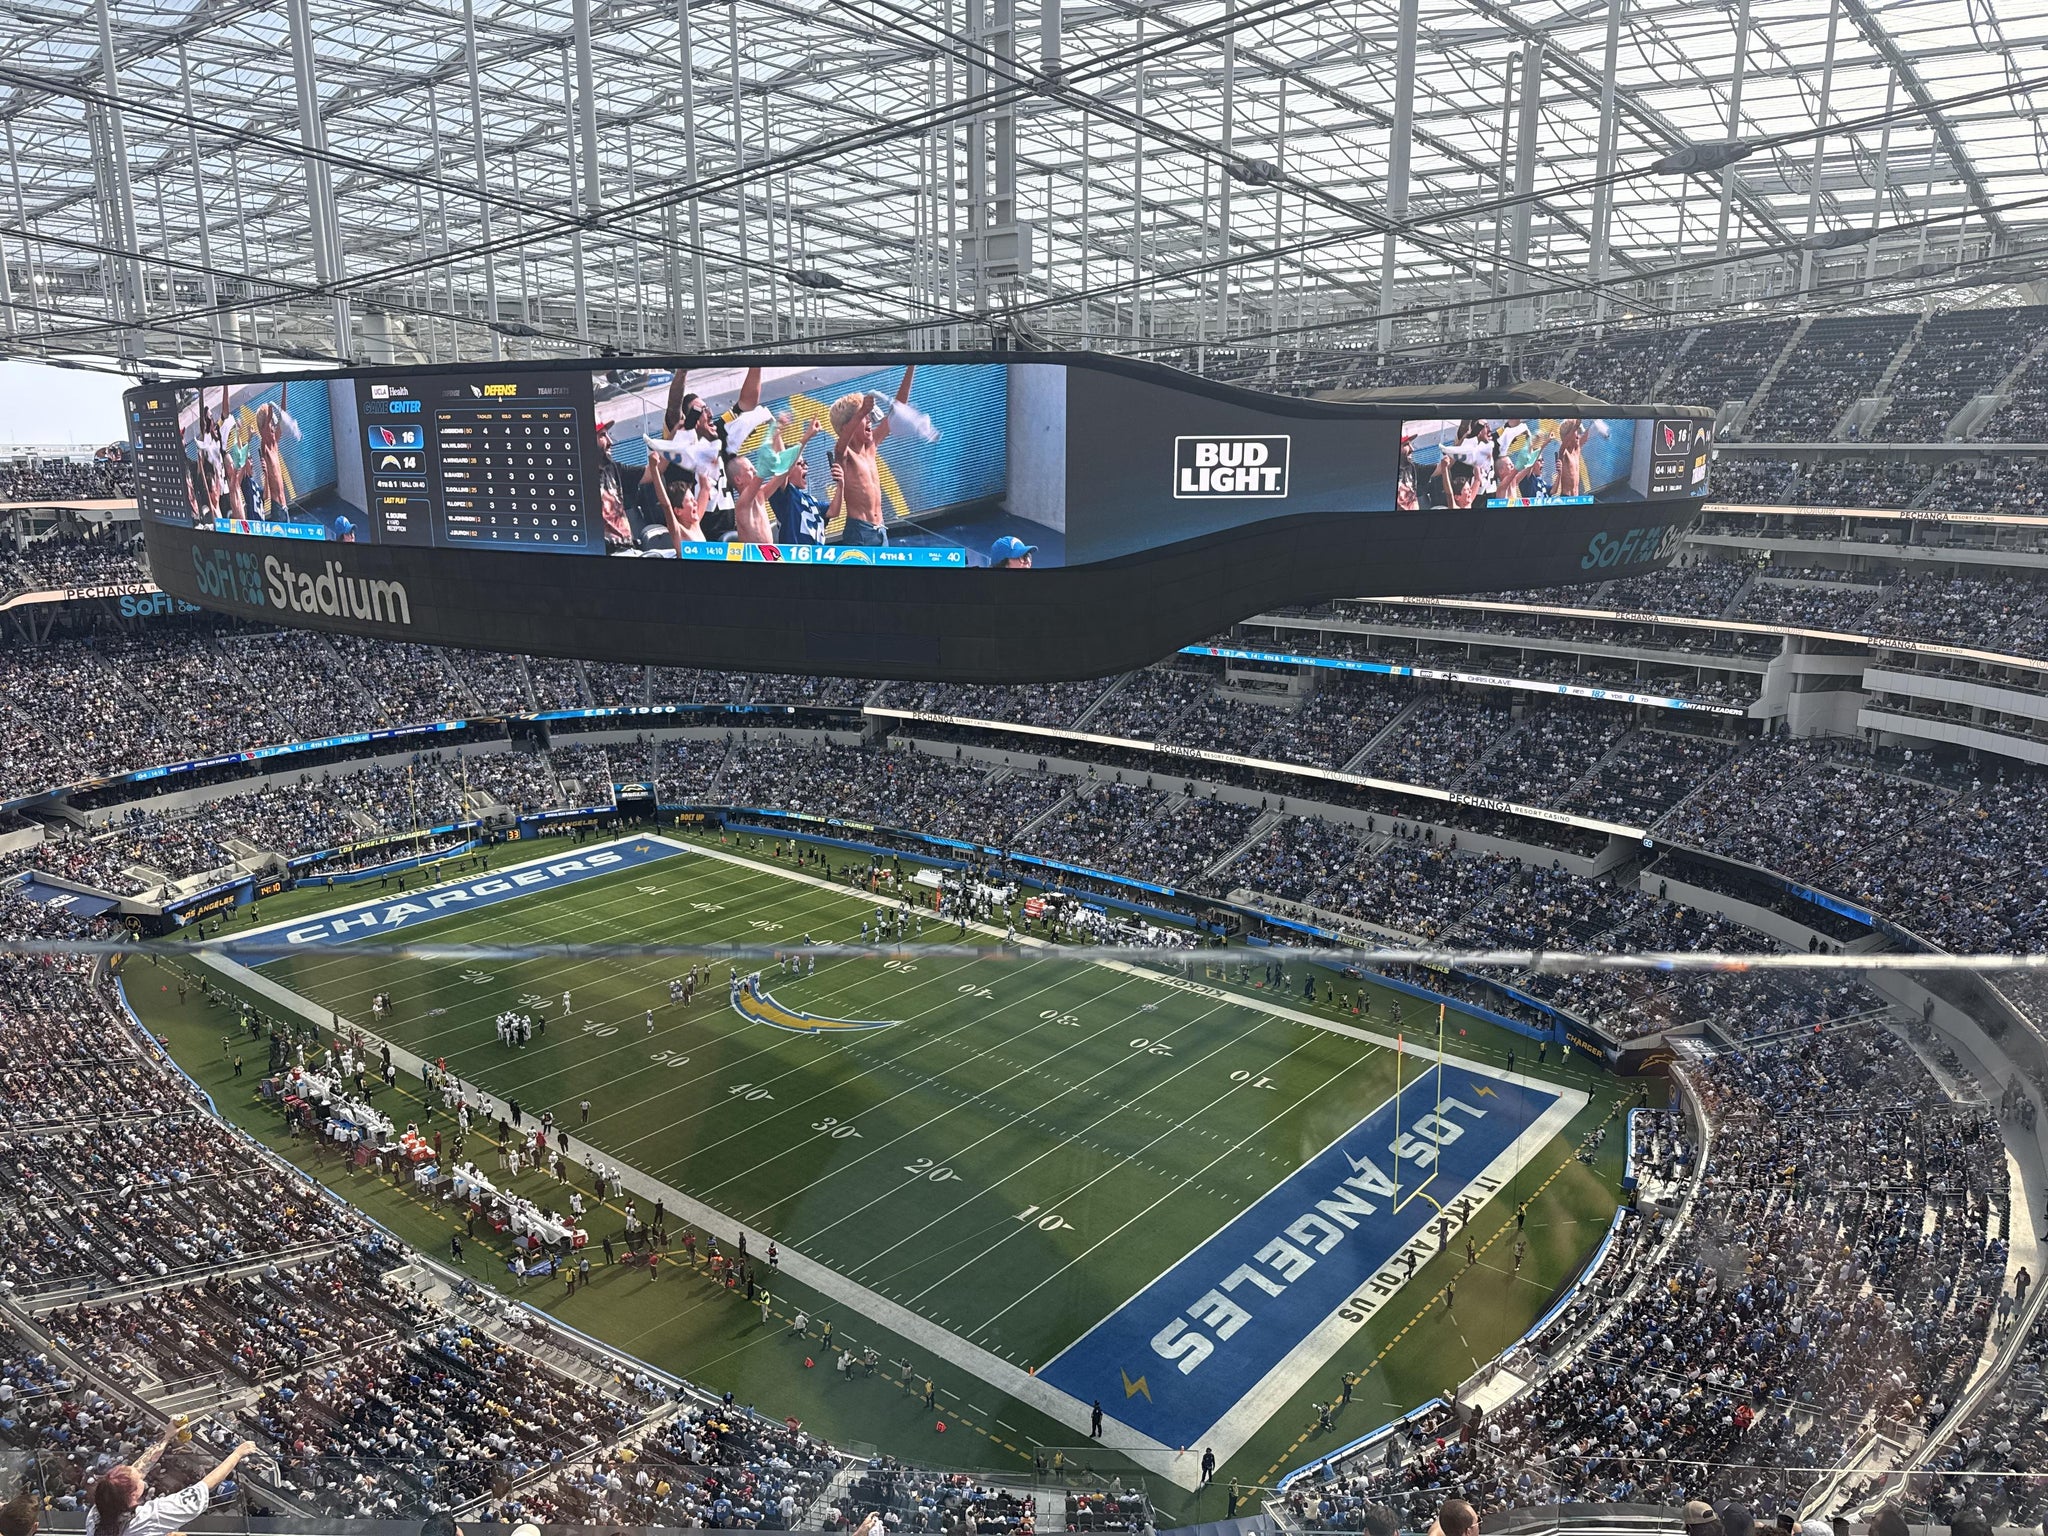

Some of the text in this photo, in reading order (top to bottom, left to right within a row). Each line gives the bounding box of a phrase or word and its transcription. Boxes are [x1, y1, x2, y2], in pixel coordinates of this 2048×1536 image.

[373, 387, 409, 396] UCLA Health
[484, 384, 517, 396] DEFENSE
[364, 401, 421, 414] GAME CENTER
[402, 431, 415, 444] 16
[483, 427, 570, 435] 4 4 0 0 0
[1678, 429, 1687, 442] 16
[564, 443, 571, 451] 0
[485, 457, 572, 466] 3 3 0 0 1
[1195, 442, 1269, 467] BUD
[403, 457, 416, 468] 14
[487, 472, 493, 480] 3
[547, 473, 554, 481] 0
[567, 473, 574, 481] 0
[1655, 465, 1665, 475] Q4
[488, 487, 575, 497] 3 3 0 0 0
[489, 501, 576, 512] 3 2 0 0 0
[490, 516, 577, 527] 2 2 0 0 0
[1900, 511, 1949, 521] PECHANGA
[252, 522, 271, 534] 16 14
[492, 531, 579, 542] 2 2 0 0 0
[684, 546, 698, 554] Q4
[706, 547, 723, 555] 14:10
[790, 547, 810, 560] 16
[815, 547, 836, 561] 14
[880, 552, 897, 560] 4TH
[897, 552, 905, 560] &
[907, 552, 913, 560] 1
[947, 552, 960, 562] 40
[1581, 528, 1645, 569] SoFi
[192, 544, 411, 624] SoFi Stadium
[67, 585, 147, 599] PECHANGA
[120, 592, 174, 618] SoFi
[1403, 596, 1440, 605] PECHANGA
[1616, 611, 1660, 622] PECHANGA
[1867, 637, 1918, 650] PECHANGA
[1489, 678, 1512, 686] OLAVE
[1558, 685, 1567, 693] 10
[1591, 690, 1606, 698] 182
[584, 706, 676, 716] EST. 1960
[1678, 702, 1744, 716] FANTASY LEADERS
[912, 711, 954, 724] PECHANGA
[1154, 743, 1246, 763] PECHANGA RESORT CASINO
[1322, 769, 1367, 785] YOUR
[1450, 793, 1570, 822] PECHANGA RESORT CASINO
[680, 814, 705, 822] BOLT UP
[800, 814, 825, 823] ANGELES
[843, 822, 875, 831] CHARGERS
[338, 829, 431, 854] LOS ANGELES CHARGERS
[508, 830, 519, 840] 33
[1643, 839, 1653, 847] CC
[260, 882, 281, 896] 14:10
[380, 885, 436, 902] NEVER
[286, 850, 622, 944] CHARGERS
[182, 910, 195, 919] LOS
[197, 895, 235, 915] ANGELES
[698, 901, 725, 914] 20
[754, 919, 784, 933] 30
[883, 959, 918, 974] 50
[957, 984, 993, 999] 40
[1153, 974, 1227, 997] KICKOFF
[521, 992, 553, 1010] 30
[1039, 1009, 1077, 1027] 30
[582, 1019, 619, 1038] 40
[1129, 1038, 1173, 1055] 20
[650, 1050, 690, 1068] 50
[1229, 1070, 1274, 1088] 10
[727, 1083, 769, 1102] 40
[811, 1116, 856, 1140] 30
[903, 1157, 953, 1183] 20
[1012, 1204, 1065, 1232] 10
[1149, 1096, 1488, 1376] LOS ANGELES
[1337, 1175, 1502, 1324] IT TAKES ALL OF US
[716, 1505, 727, 1513] 64
